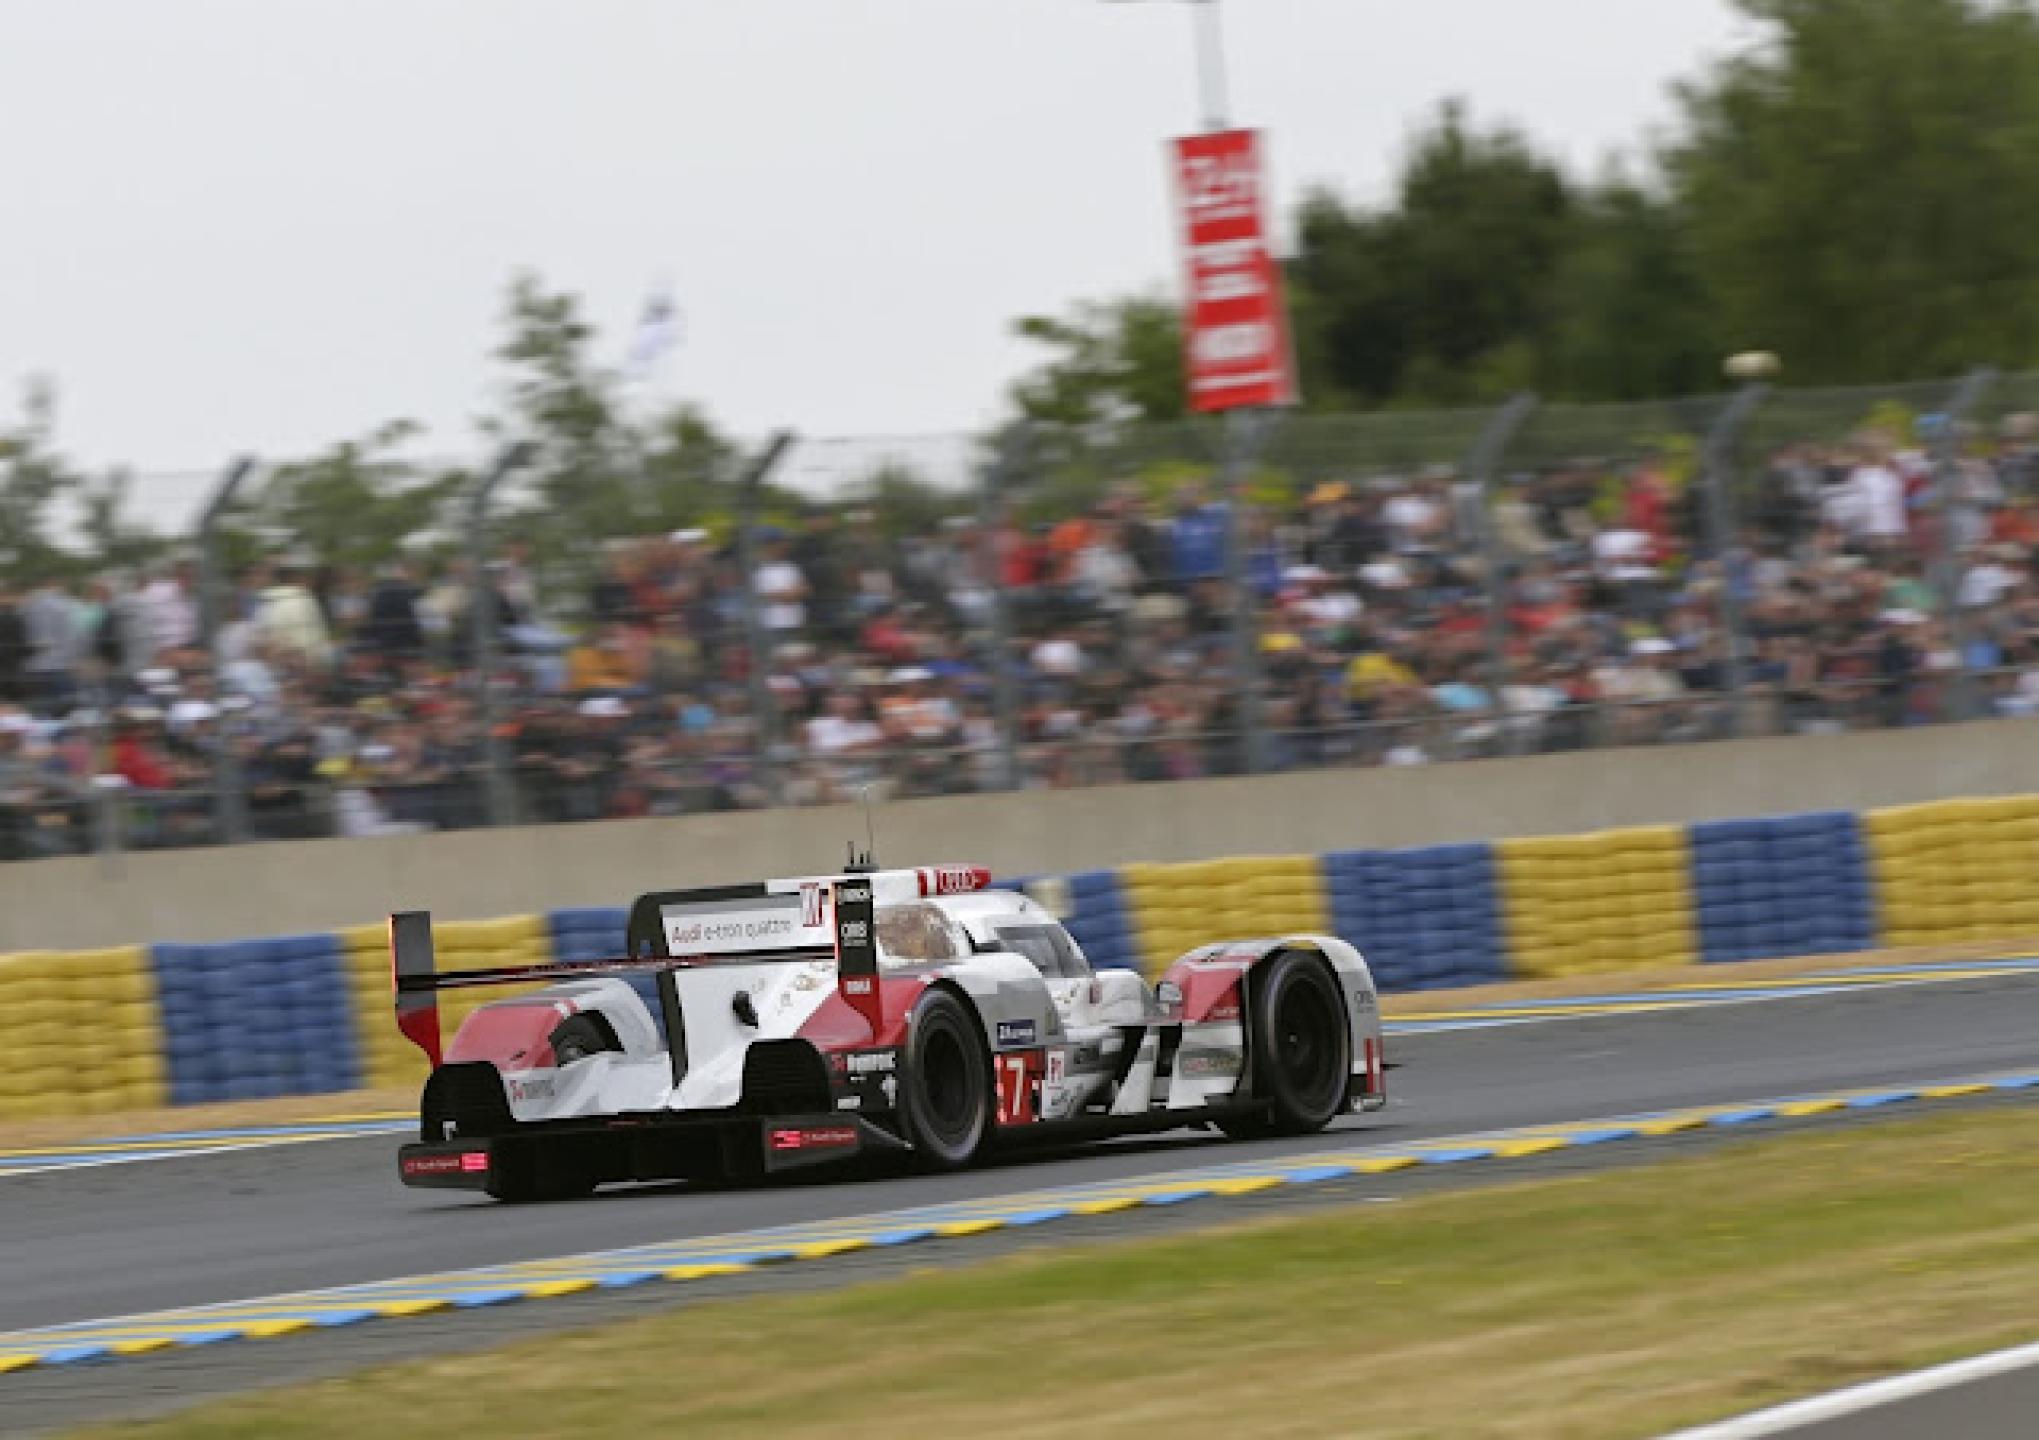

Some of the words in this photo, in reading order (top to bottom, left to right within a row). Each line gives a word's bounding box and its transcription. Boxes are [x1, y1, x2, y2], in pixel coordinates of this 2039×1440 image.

[671, 923, 702, 943] Audi
[703, 919, 742, 940] e-tron
[744, 919, 791, 941] quattro
[1006, 1057, 1024, 1116] 7
